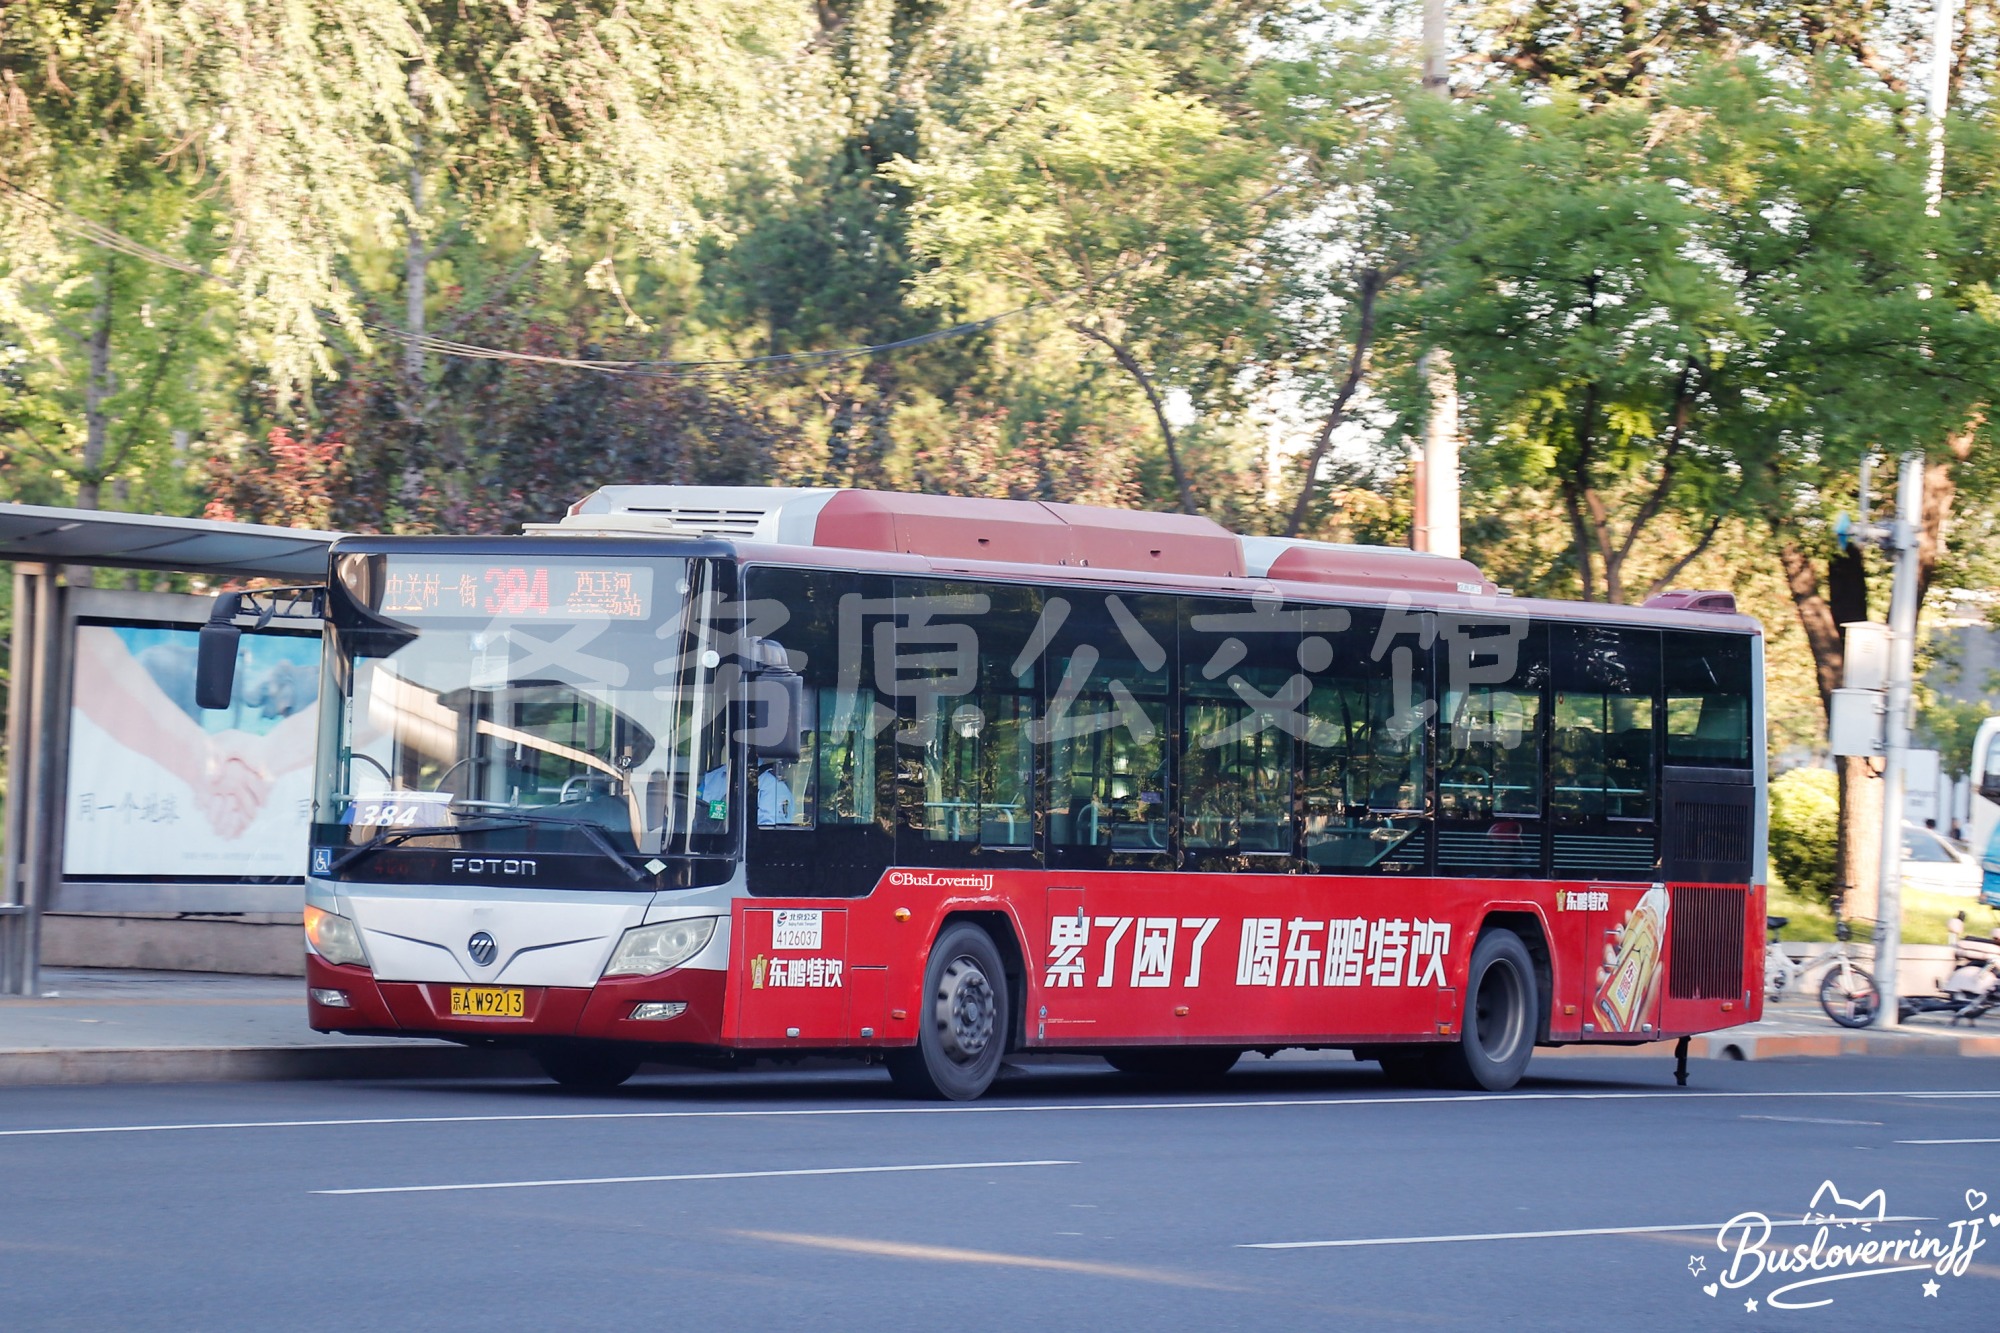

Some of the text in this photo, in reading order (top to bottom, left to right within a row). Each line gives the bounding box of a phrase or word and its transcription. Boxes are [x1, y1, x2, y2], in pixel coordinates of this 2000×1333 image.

[385, 573, 478, 608] 中关村一街
[484, 568, 549, 615] 384
[575, 571, 633, 594] 西玉河
[355, 804, 419, 827] 384
[451, 858, 537, 876] FOTON
[1565, 890, 1609, 912] 东鹏特饮
[789, 912, 818, 921] 北京公交
[776, 930, 818, 946] 4126037
[1043, 915, 1452, 988] 累了困了 喝东鹏特饮
[768, 956, 843, 988] 东鹏特饮
